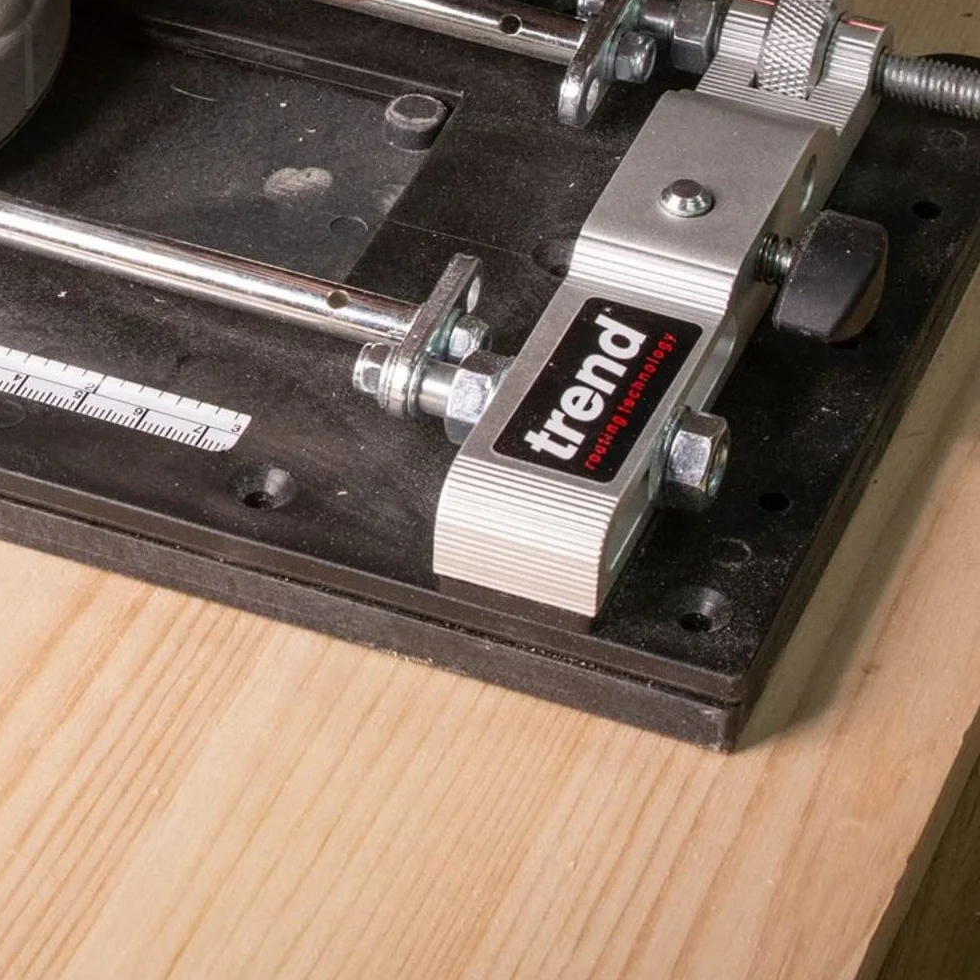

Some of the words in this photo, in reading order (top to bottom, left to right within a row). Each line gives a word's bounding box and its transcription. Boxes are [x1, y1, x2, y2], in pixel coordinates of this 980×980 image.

[85, 383, 95, 392] 2
[231, 424, 242, 433] 3
[583, 414, 629, 470] routing
[617, 332, 678, 416] technology
